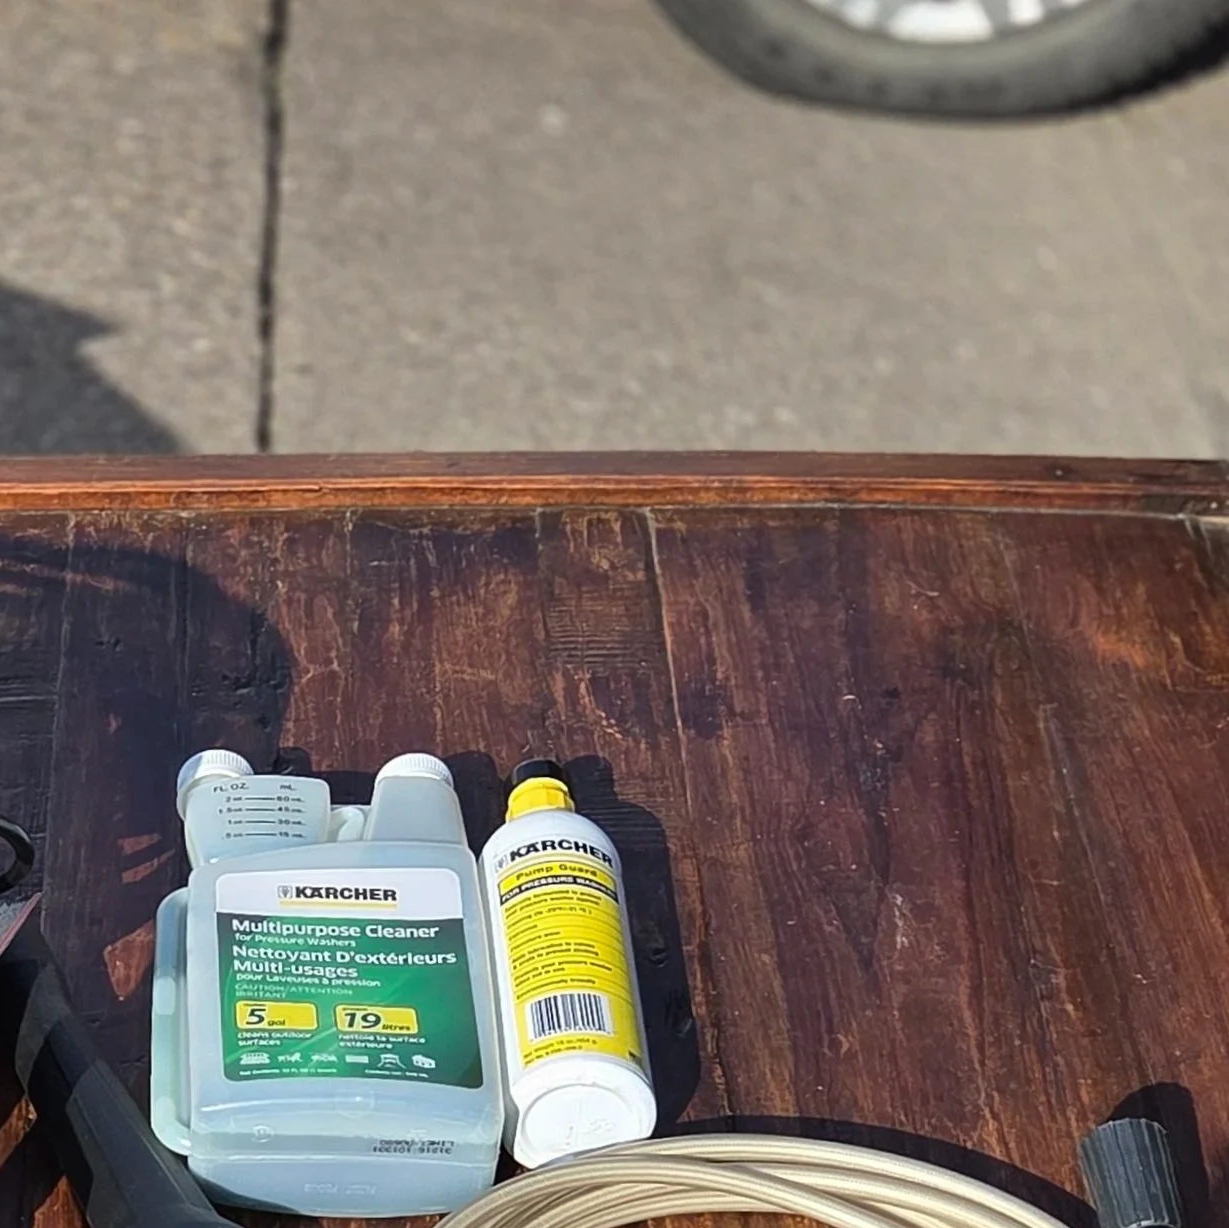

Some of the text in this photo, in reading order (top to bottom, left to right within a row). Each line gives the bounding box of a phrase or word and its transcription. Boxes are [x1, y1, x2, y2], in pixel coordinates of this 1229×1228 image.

[516, 867, 553, 880] Pump
[232, 919, 439, 938] Multipurpose Cleaner
[235, 933, 356, 947] for Pressure Washers
[233, 945, 456, 965] Nettoyant D'extérieurs
[233, 960, 358, 978] Multi-usages
[236, 973, 263, 982] pour
[266, 975, 319, 984] Laveuses
[332, 977, 381, 988] pression
[246, 1008, 266, 1025] 5
[344, 1012, 381, 1029] 19
[238, 1039, 280, 1047] surfaces
